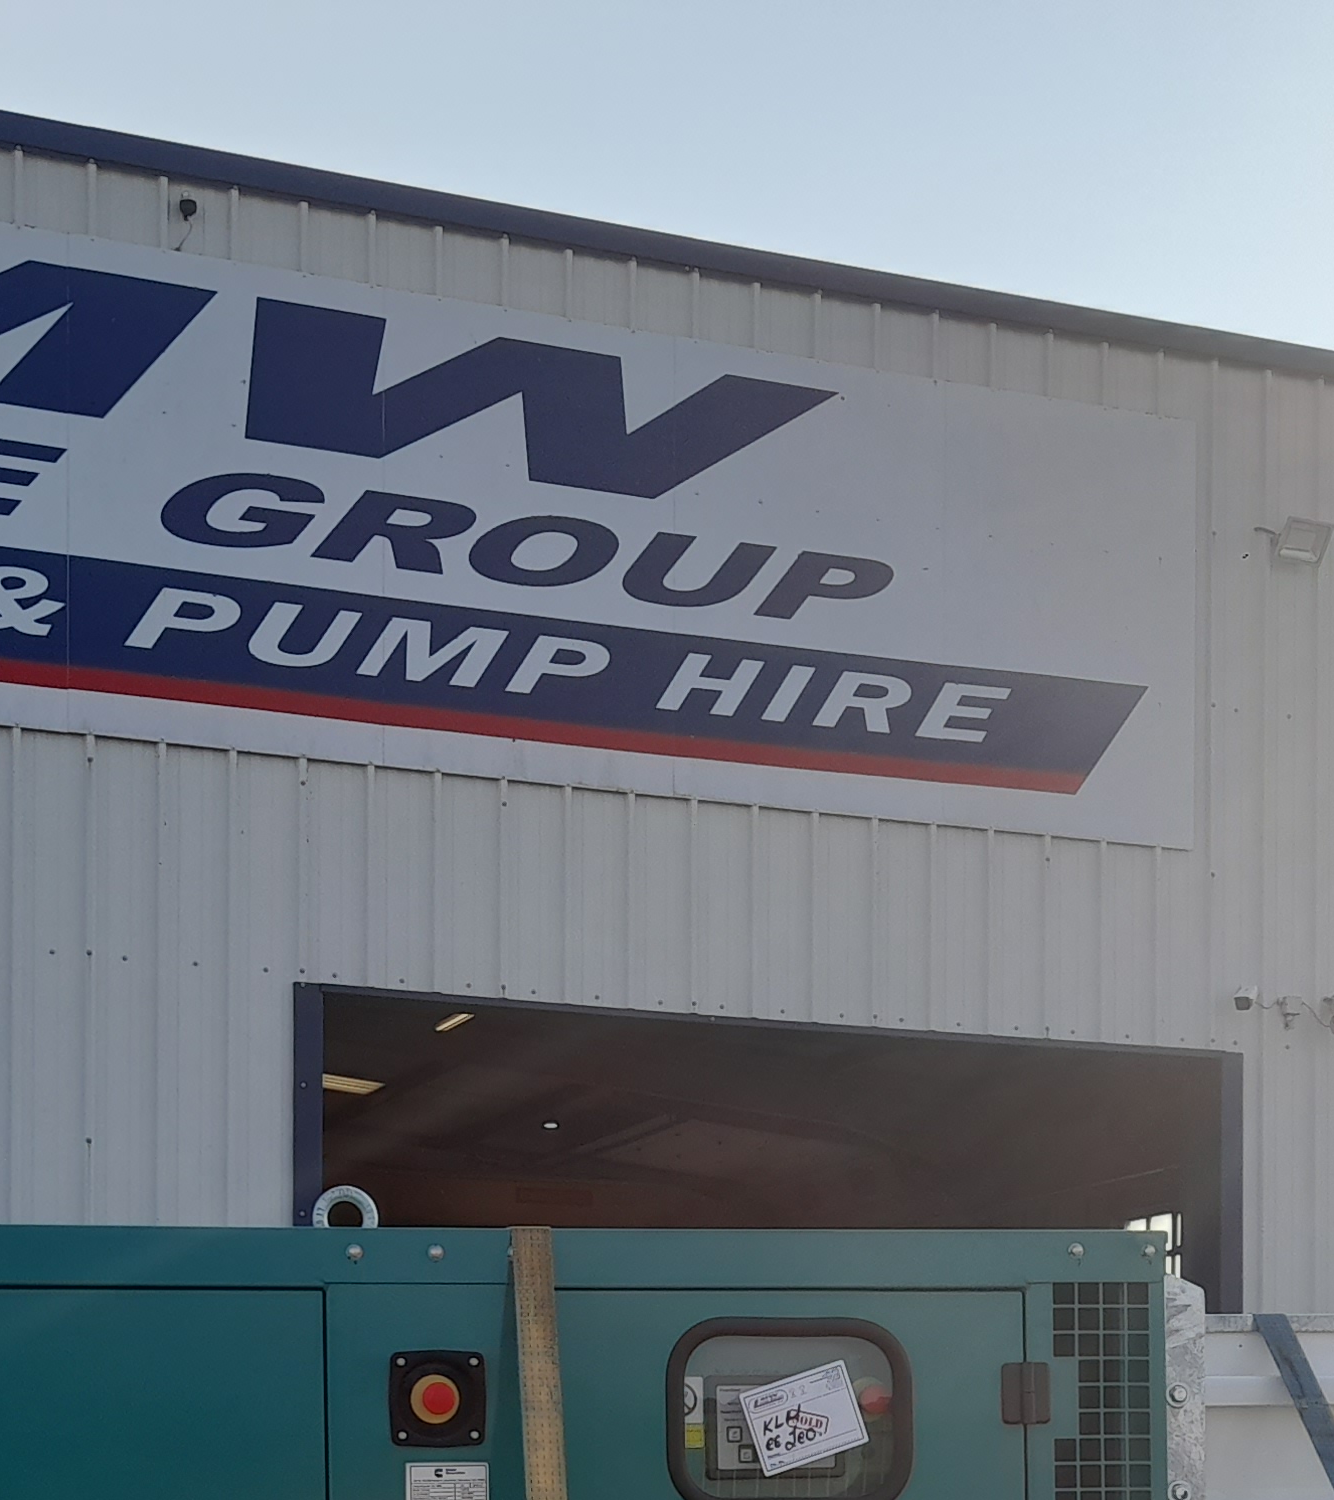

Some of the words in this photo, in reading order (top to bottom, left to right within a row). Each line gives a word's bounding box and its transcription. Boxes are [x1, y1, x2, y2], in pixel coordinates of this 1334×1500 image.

[160, 473, 895, 619] GROUP
[123, 587, 611, 696] PUMP
[656, 652, 1012, 744] HIRE
